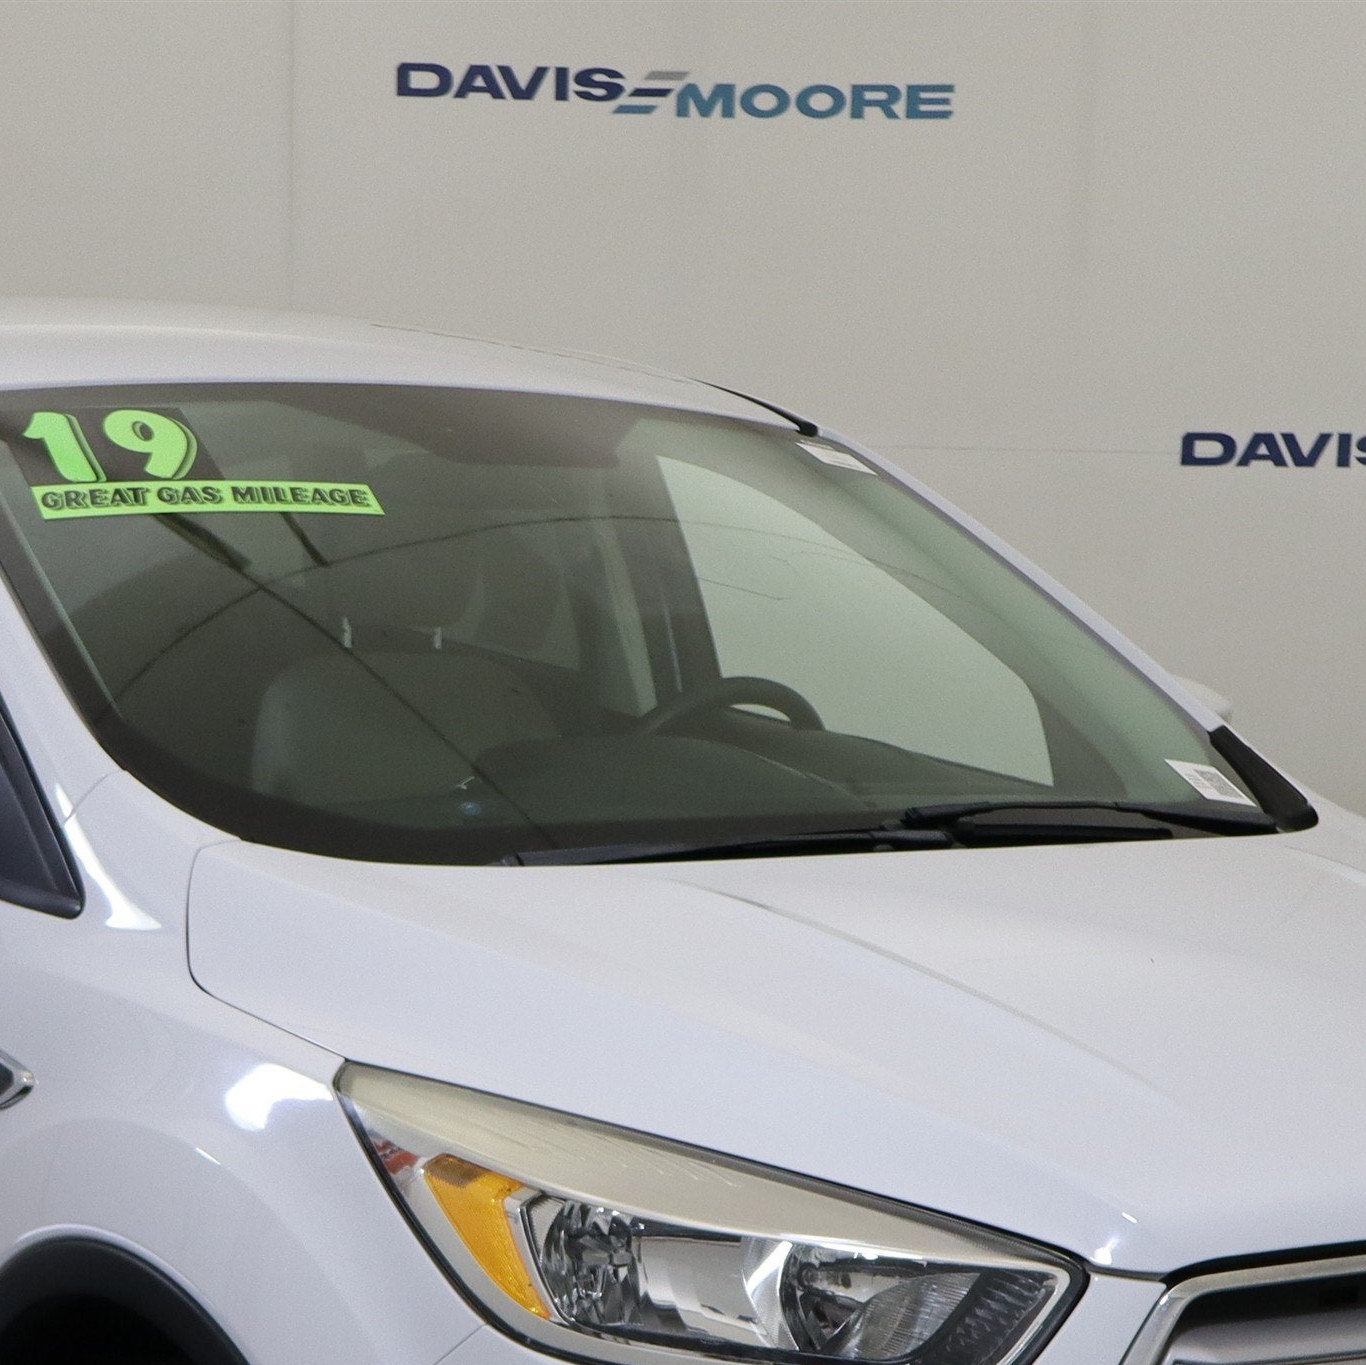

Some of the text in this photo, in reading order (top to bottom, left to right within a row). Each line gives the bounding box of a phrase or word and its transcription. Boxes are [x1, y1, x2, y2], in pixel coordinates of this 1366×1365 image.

[396, 61, 956, 119] DAVIS MOORE
[22, 409, 199, 483] 19
[40, 485, 373, 513] GREAT GAS MILEAGE
